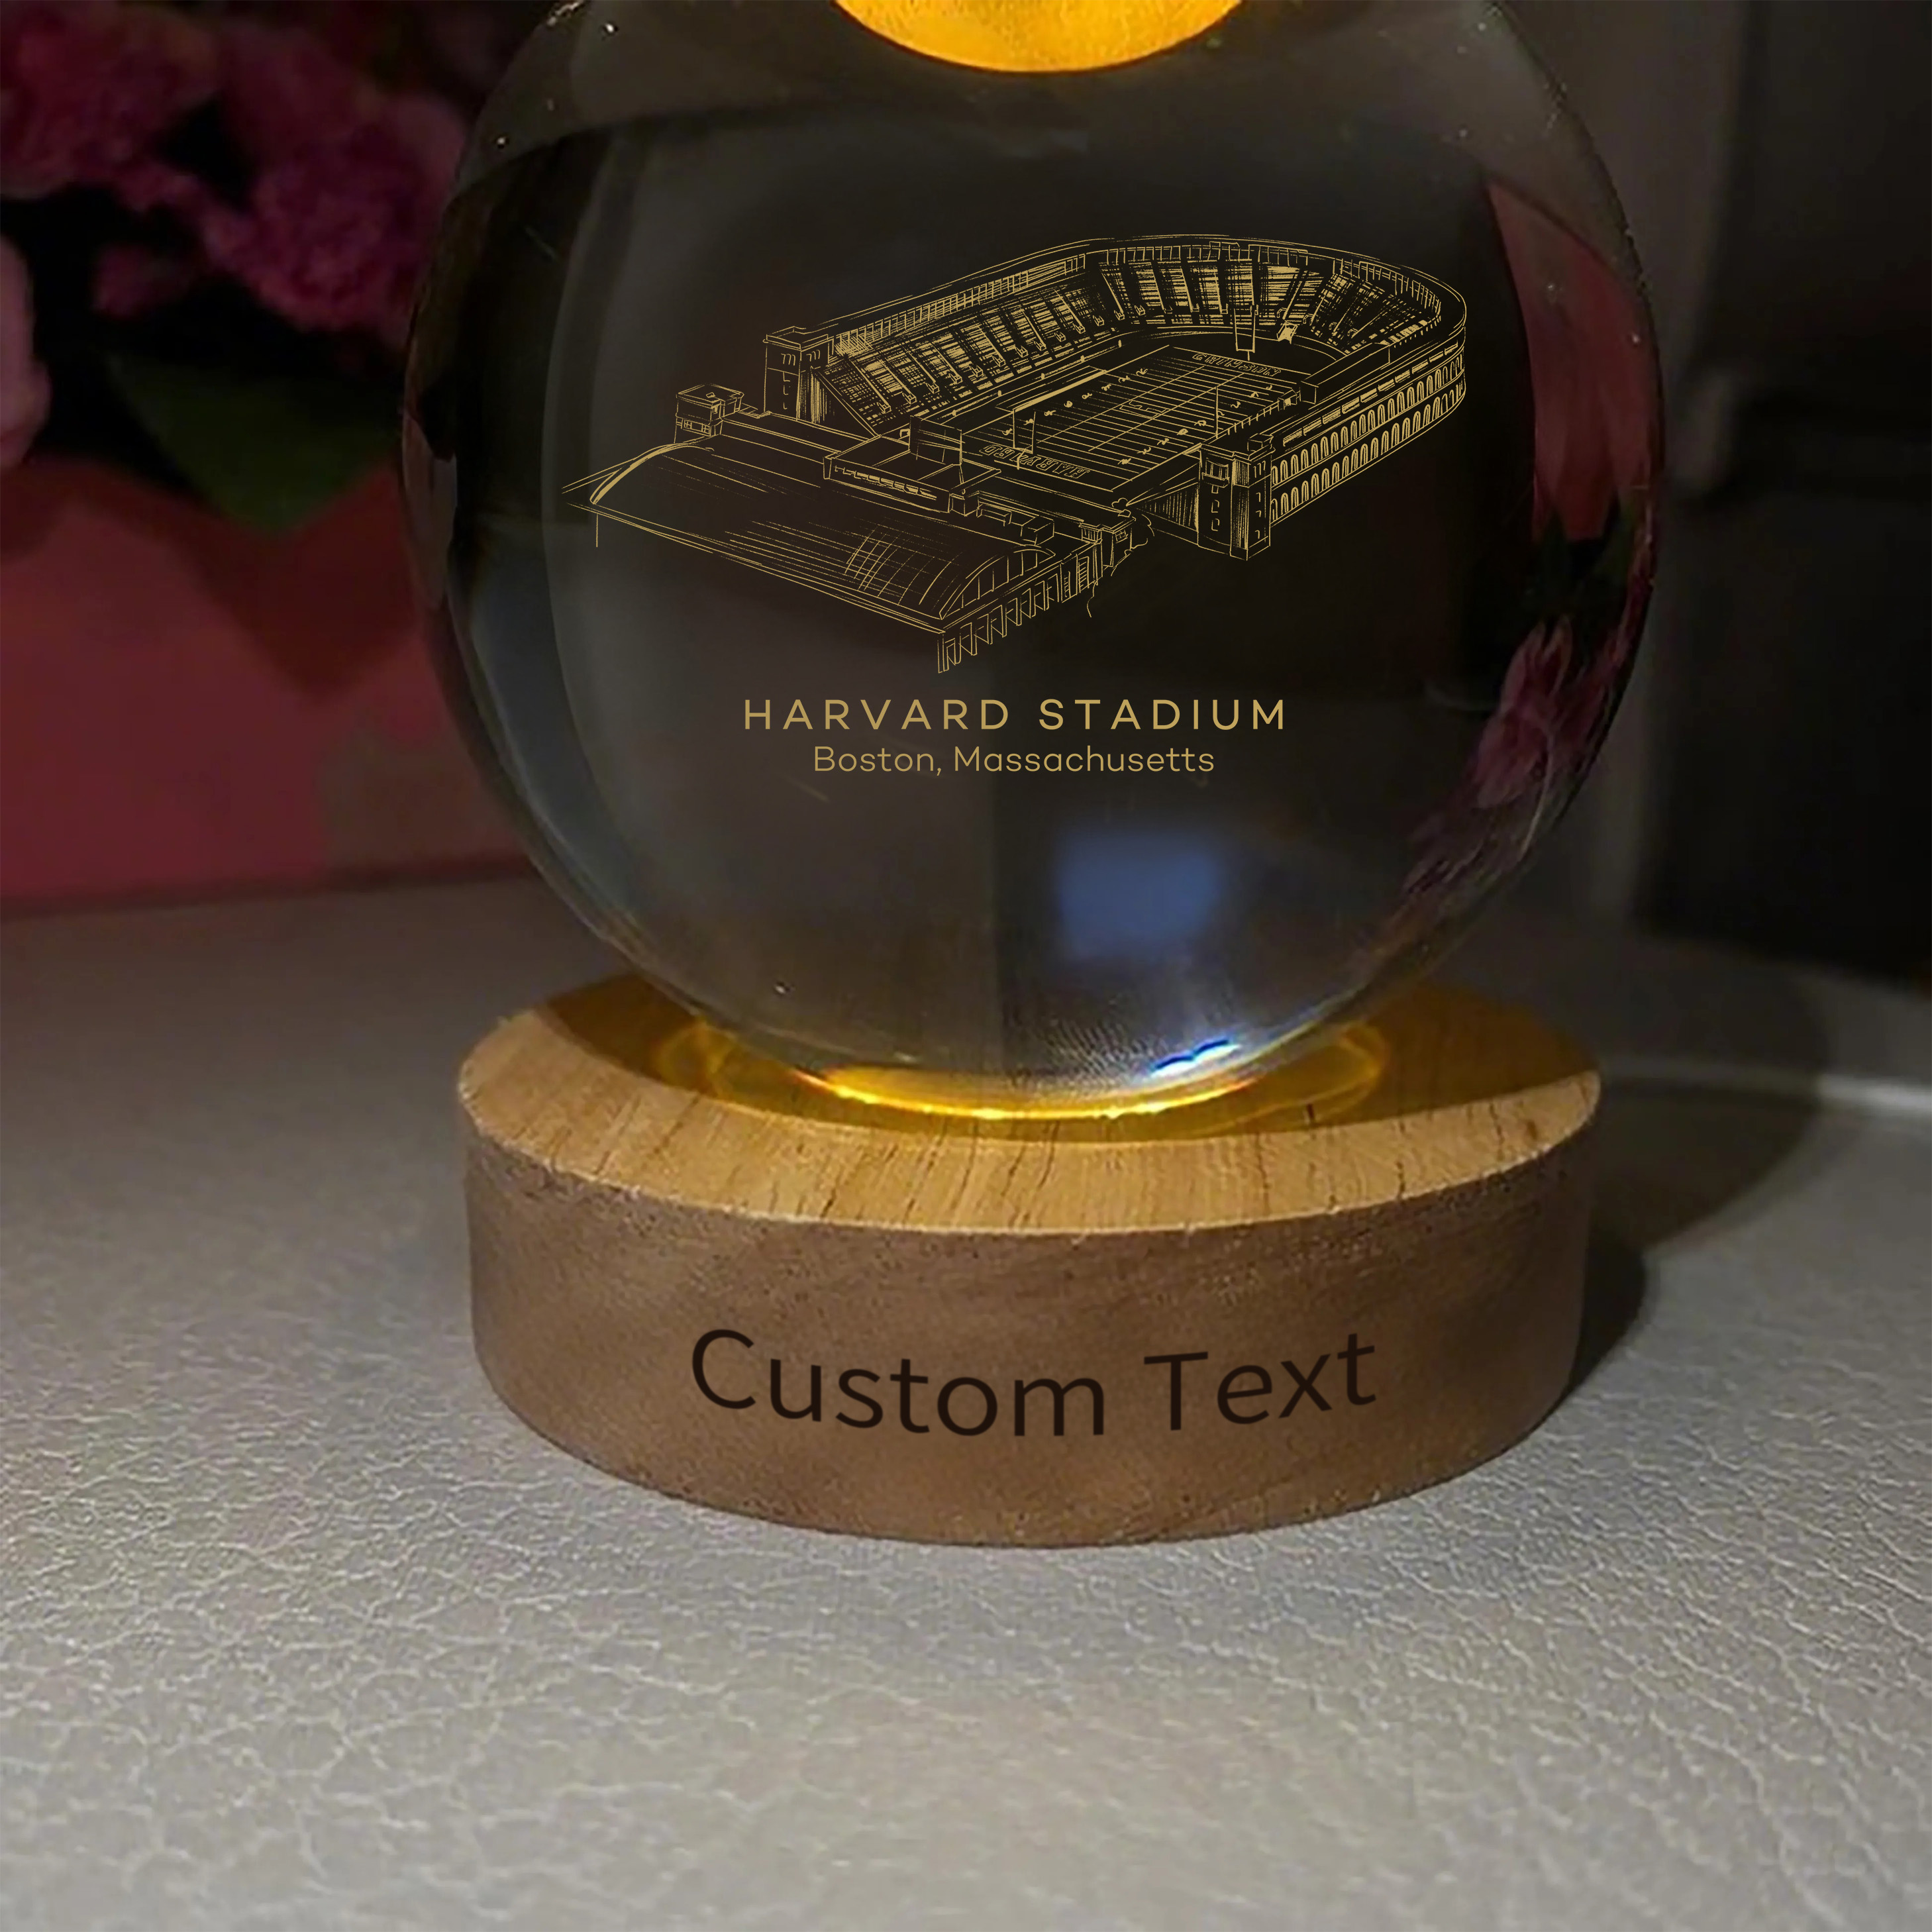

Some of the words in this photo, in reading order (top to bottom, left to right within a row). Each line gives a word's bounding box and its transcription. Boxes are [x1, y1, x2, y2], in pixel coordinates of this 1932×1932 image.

[745, 699, 1009, 730] HARVARD
[1039, 699, 1284, 731] STADIUM
[815, 746, 942, 776] Boston,
[955, 746, 1215, 772] Massachusetts
[692, 1329, 1105, 1437] Custom
[1144, 1333, 1377, 1431] Text
